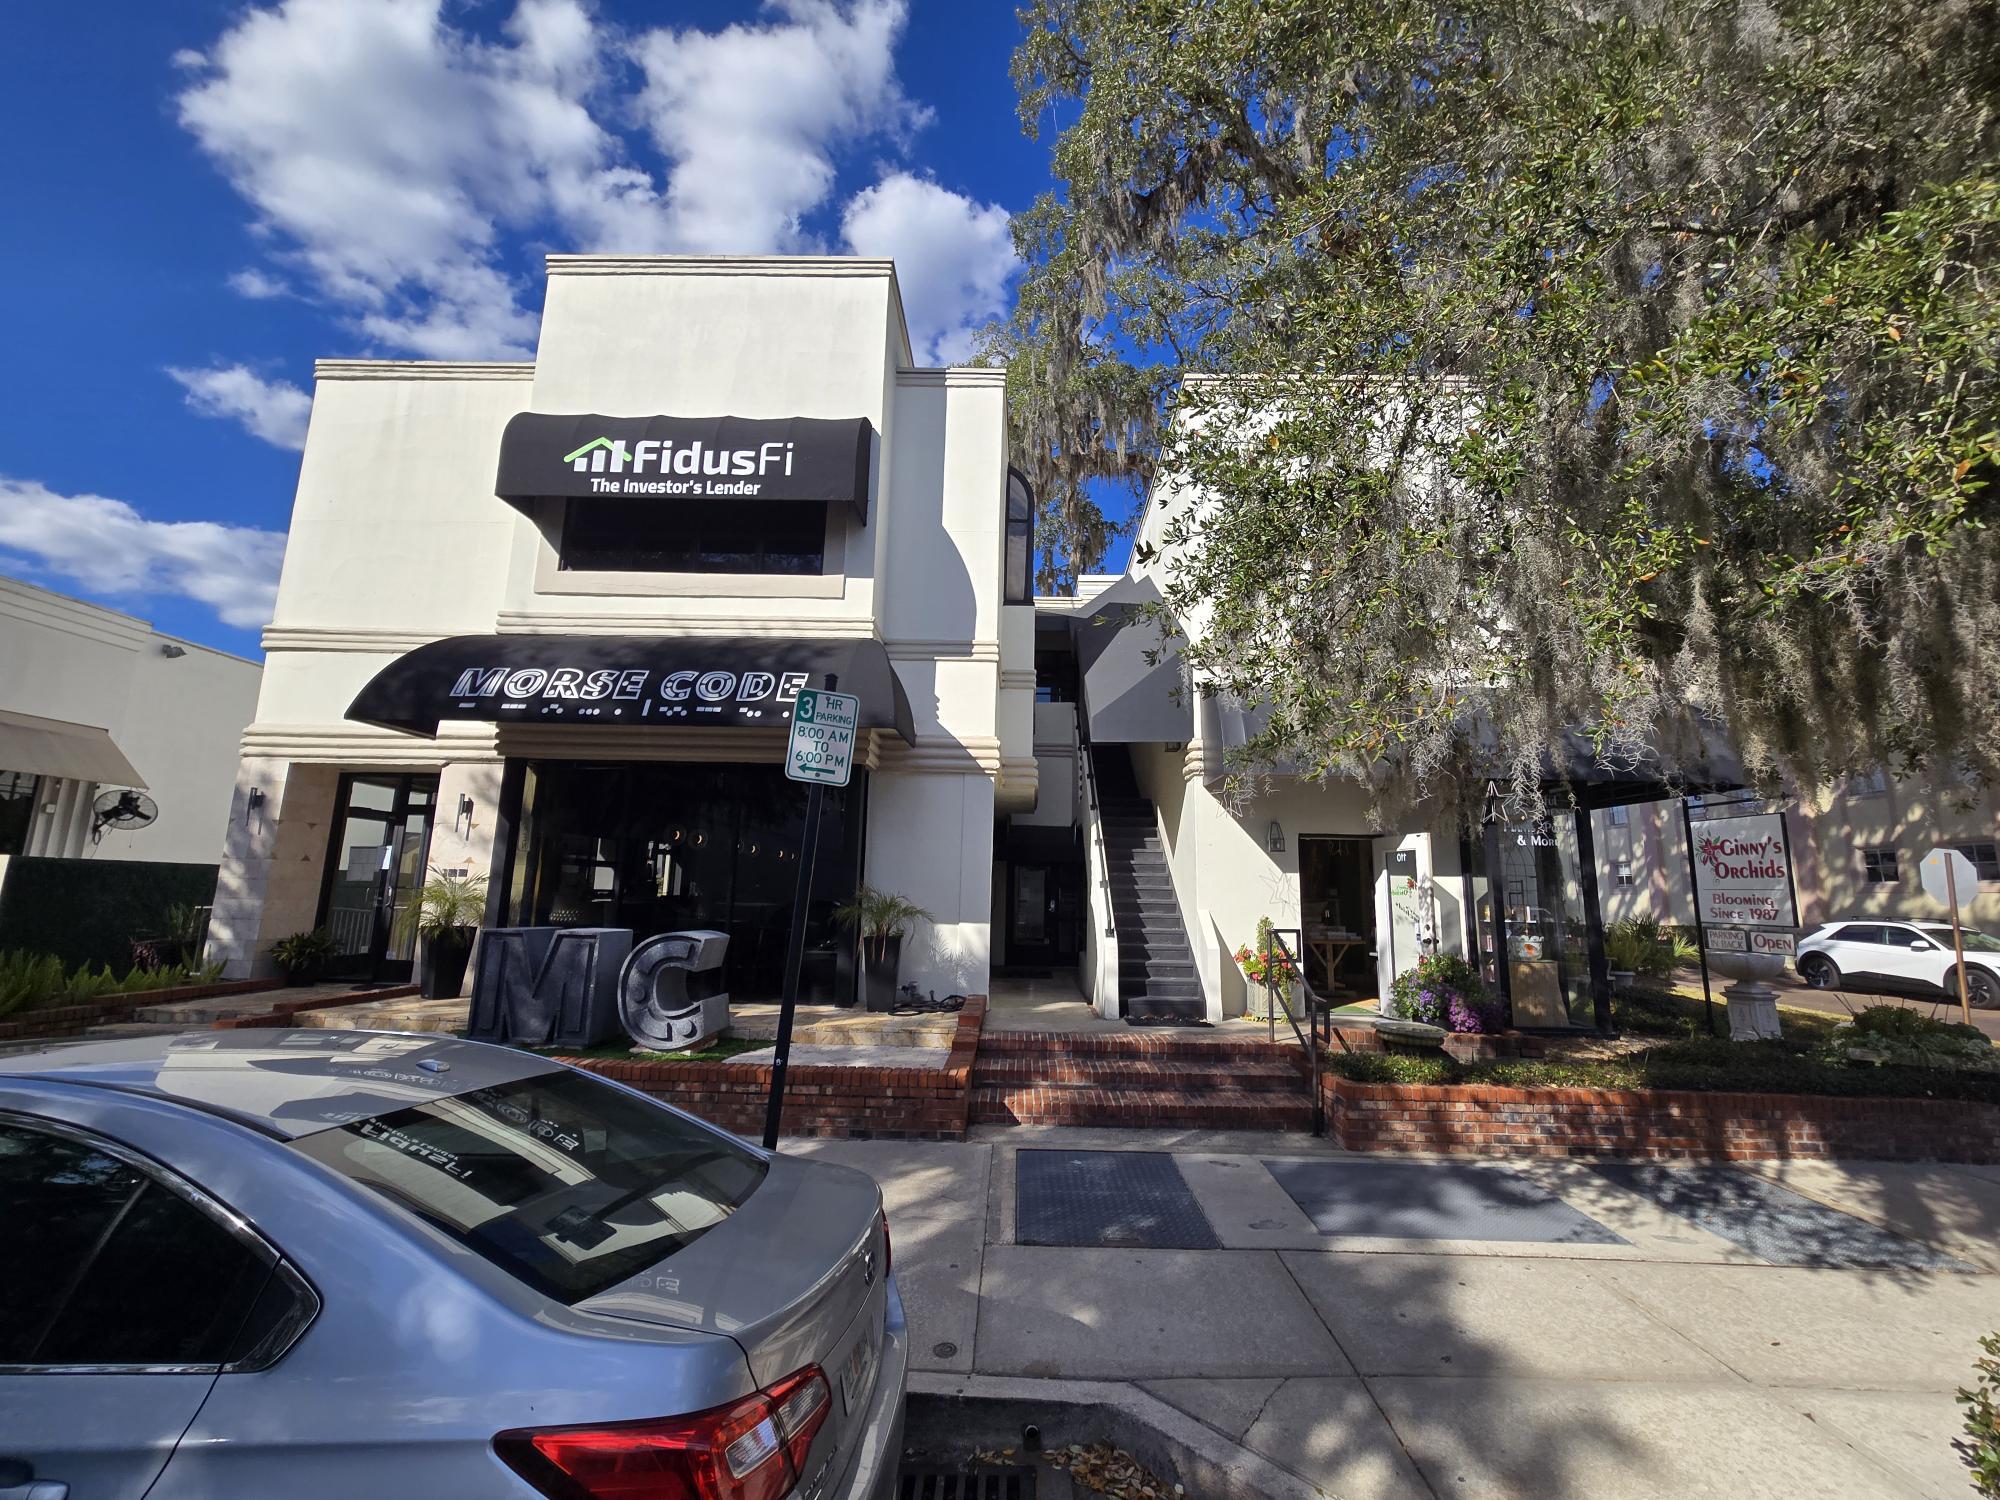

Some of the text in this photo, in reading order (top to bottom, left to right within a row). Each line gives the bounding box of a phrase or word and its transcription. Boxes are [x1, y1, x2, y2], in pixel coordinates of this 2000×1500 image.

[633, 439, 794, 476] FidusFi
[590, 478, 760, 495] The Investor's Lender
[449, 667, 809, 703] MORSE CODE
[799, 696, 813, 718] 3
[826, 699, 842, 710] HR
[815, 711, 851, 725] PARKING
[797, 726, 848, 743] 8:00 AM
[813, 740, 828, 752] TO
[795, 750, 844, 767] 6:00 PM
[1517, 834, 1526, 846] &
[1720, 836, 1782, 858] Ginny's
[1714, 858, 1785, 879] Orchids
[1749, 908, 1778, 920] 1987
[1709, 930, 1743, 940] PARKING
